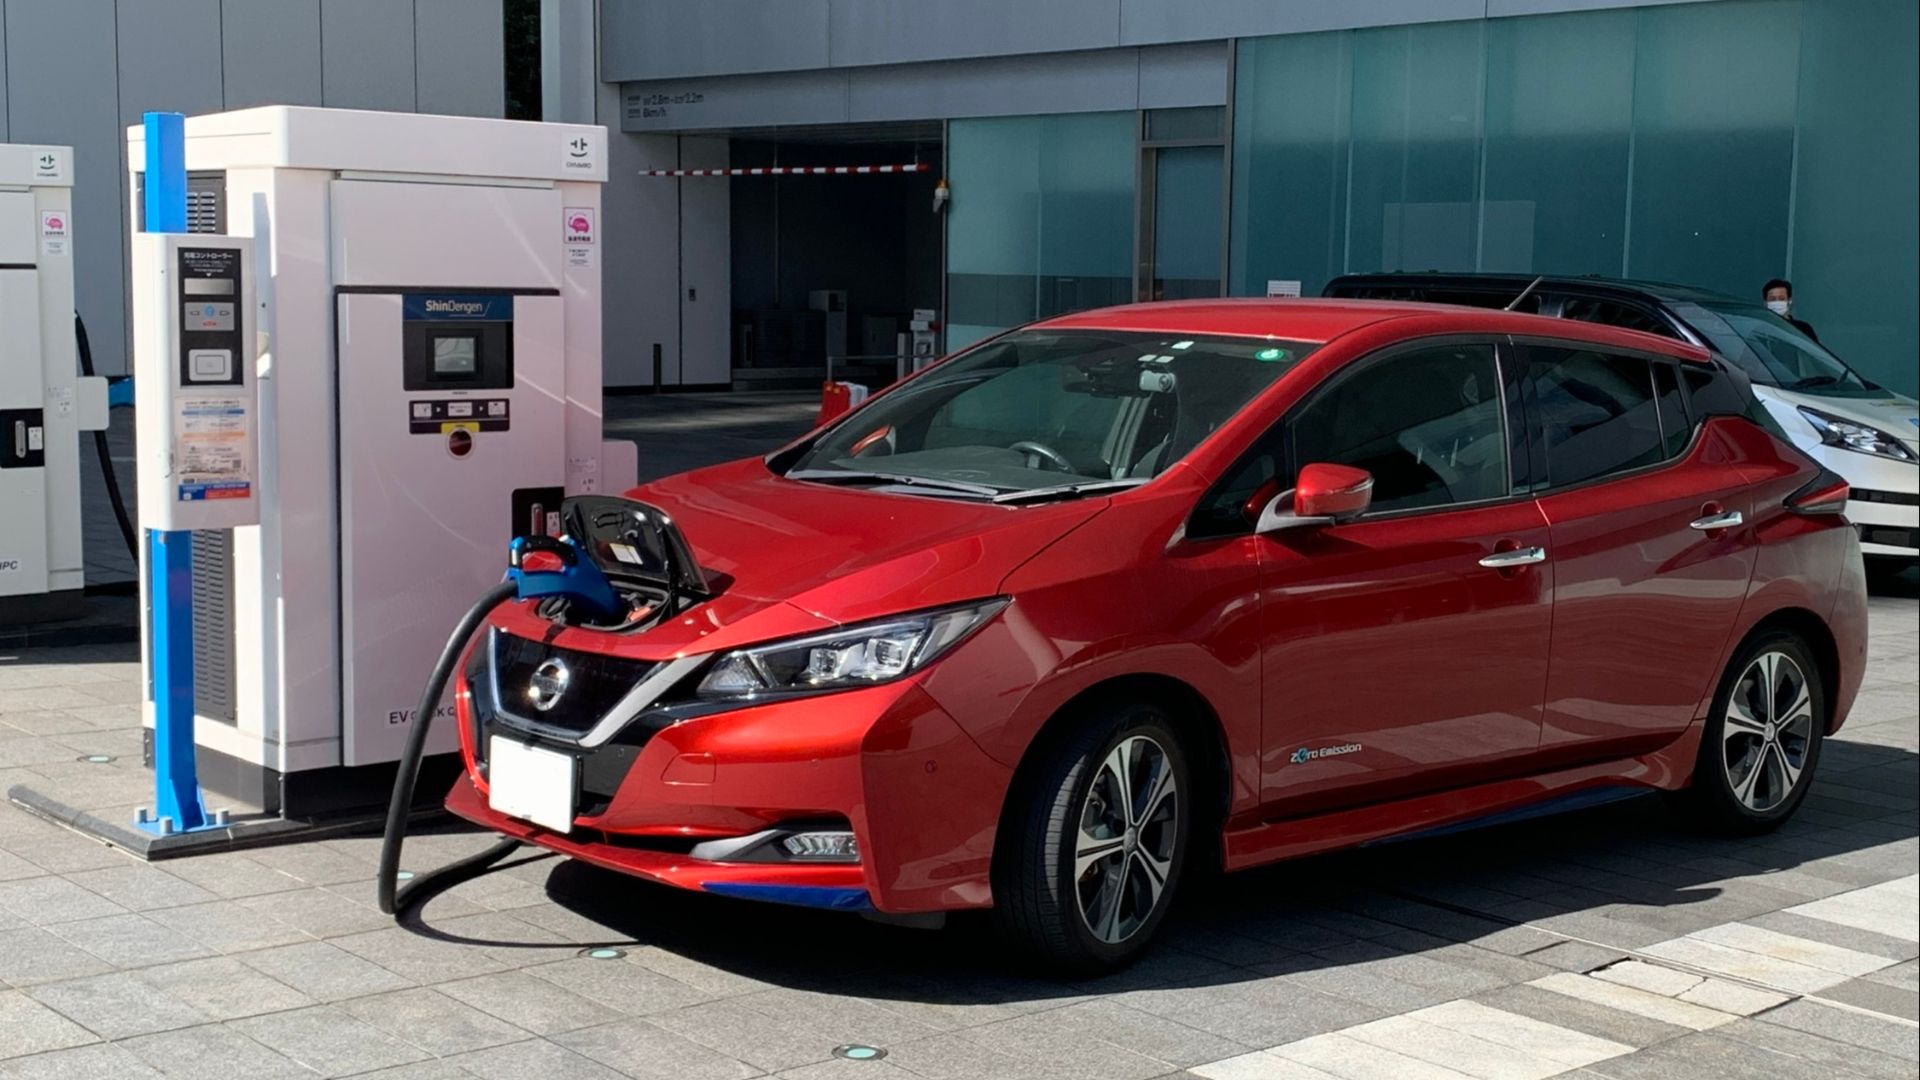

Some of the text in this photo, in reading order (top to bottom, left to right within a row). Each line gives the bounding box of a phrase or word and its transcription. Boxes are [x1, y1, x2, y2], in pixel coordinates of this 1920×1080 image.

[425, 299, 483, 314] ShinDengen
[389, 711, 408, 724] EV
[1319, 743, 1362, 757] Emission
